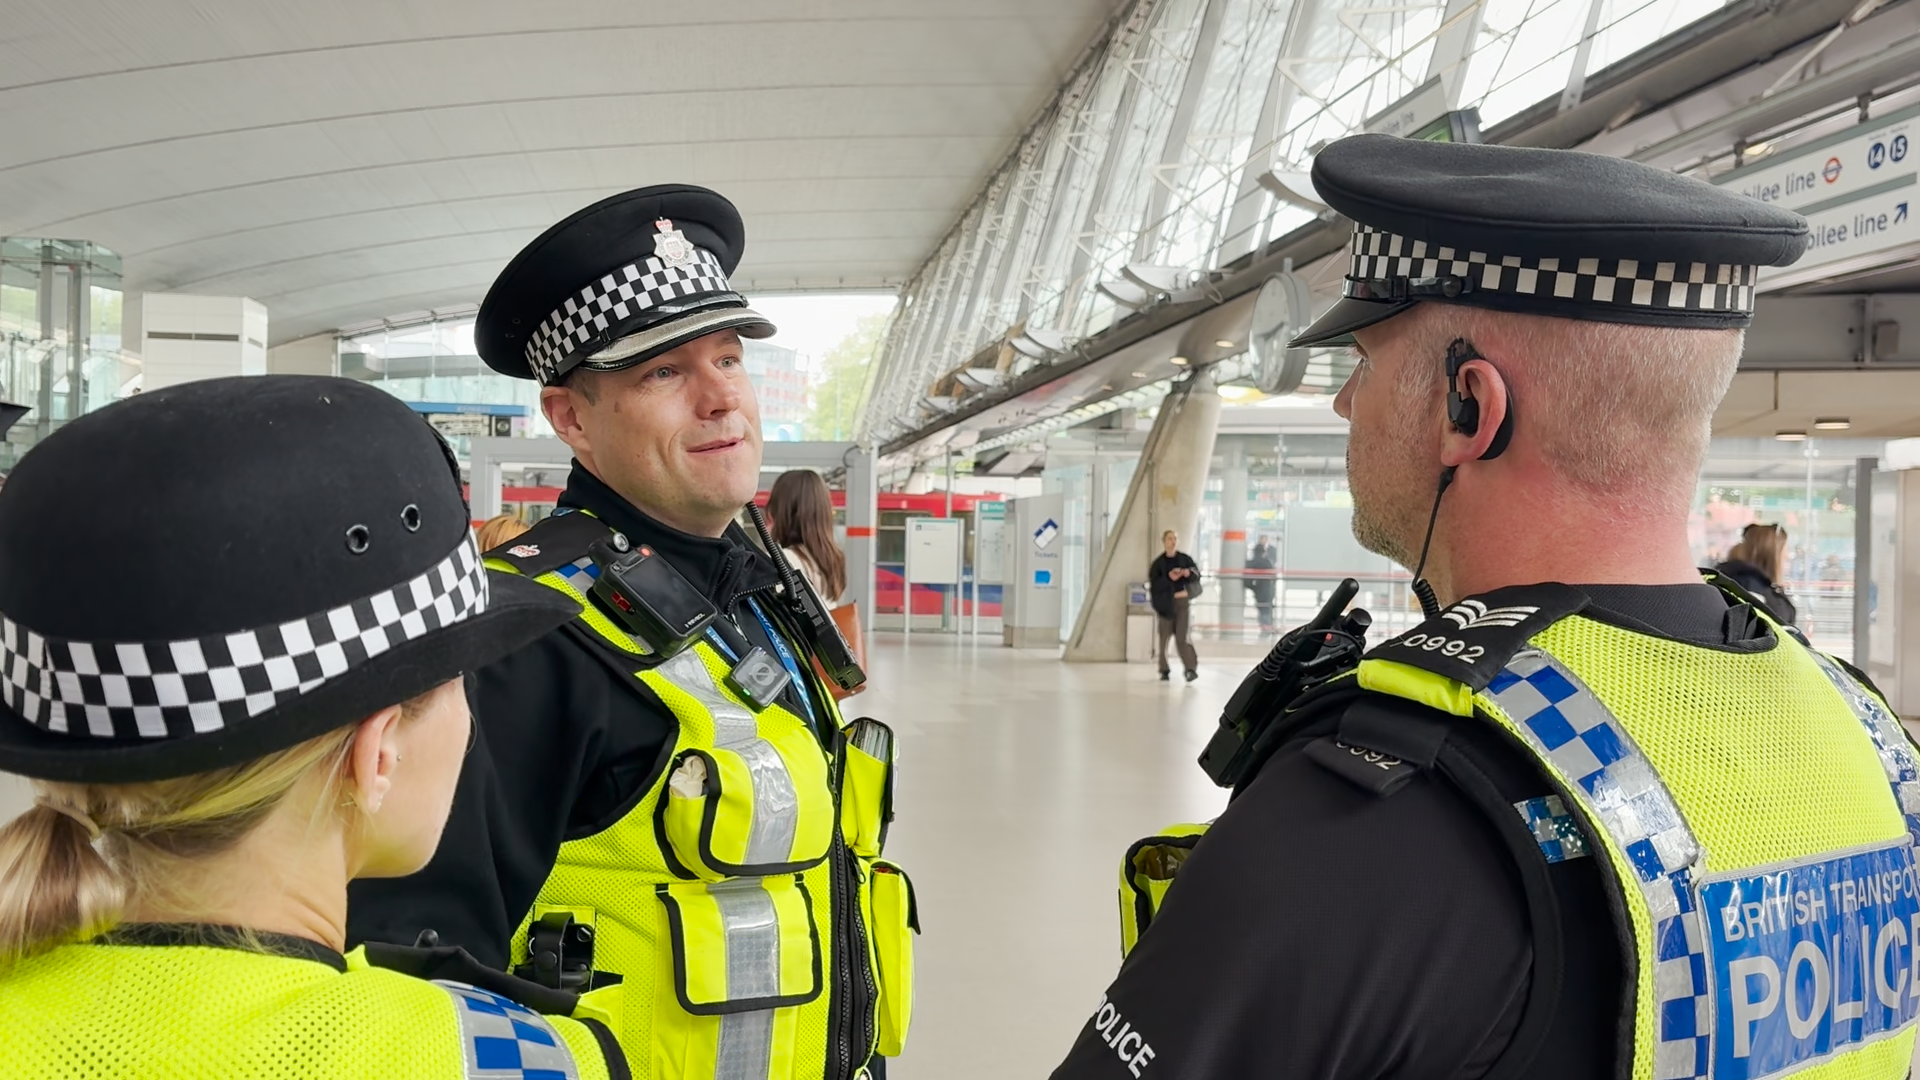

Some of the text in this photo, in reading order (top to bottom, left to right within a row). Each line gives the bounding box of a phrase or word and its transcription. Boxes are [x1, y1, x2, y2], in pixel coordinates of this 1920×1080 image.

[1891, 137, 1907, 161] 15
[1785, 171, 1816, 195] line
[1854, 213, 1888, 238] line
[768, 627, 790, 659] POLICE
[1402, 633, 1485, 665] 0992
[1720, 887, 1829, 944] BRITISH
